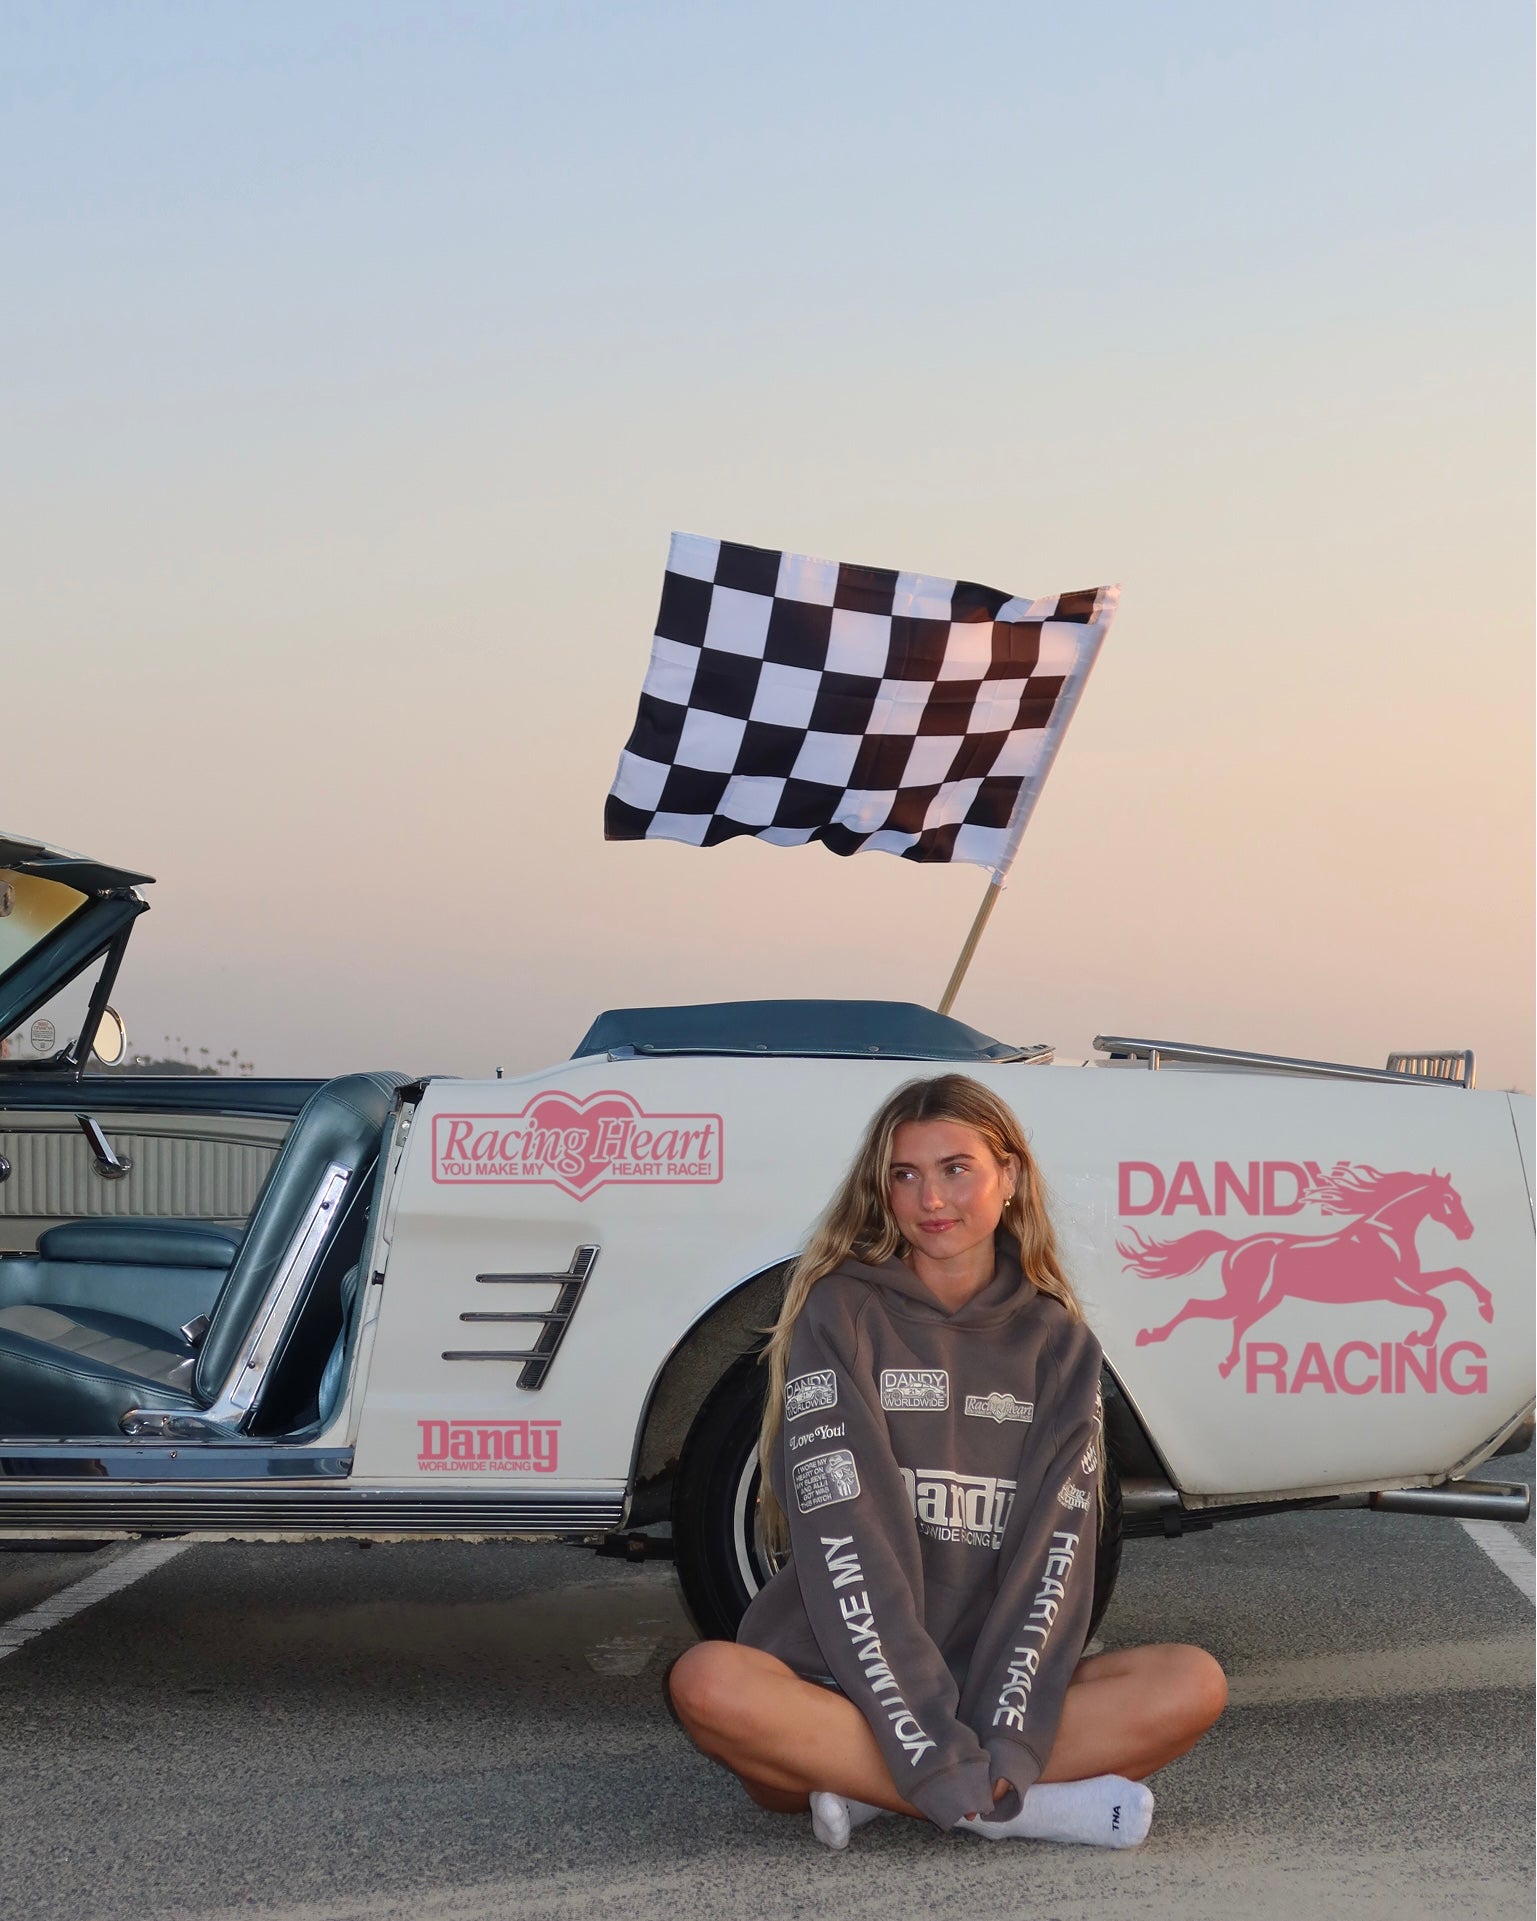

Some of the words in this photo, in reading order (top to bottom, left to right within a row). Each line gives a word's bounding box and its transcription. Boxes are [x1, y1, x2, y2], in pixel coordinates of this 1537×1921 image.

[441, 1119, 588, 1175] Racing
[591, 1119, 715, 1162] Heart
[441, 1163, 472, 1176] YOU
[475, 1163, 518, 1176] MAKE
[523, 1163, 544, 1176] MY
[612, 1163, 663, 1176] HEART
[667, 1163, 712, 1176] RACE!
[787, 1373, 832, 1399] DANDY
[885, 1373, 945, 1389] DANDY
[1246, 1340, 1488, 1395] RACING
[787, 1397, 832, 1417] WORLDWIDE
[885, 1398, 945, 1407] WORLDWIDE
[417, 1420, 562, 1473] Dandy
[789, 1433, 815, 1450] Love
[814, 1422, 845, 1440] You!
[418, 1461, 486, 1471] WORLDWIDE
[489, 1461, 531, 1471] RACING
[820, 1536, 865, 1590] MY
[1022, 1531, 1080, 1650] HEART
[840, 1591, 900, 1694] MAKE
[992, 1647, 1040, 1732] RACE
